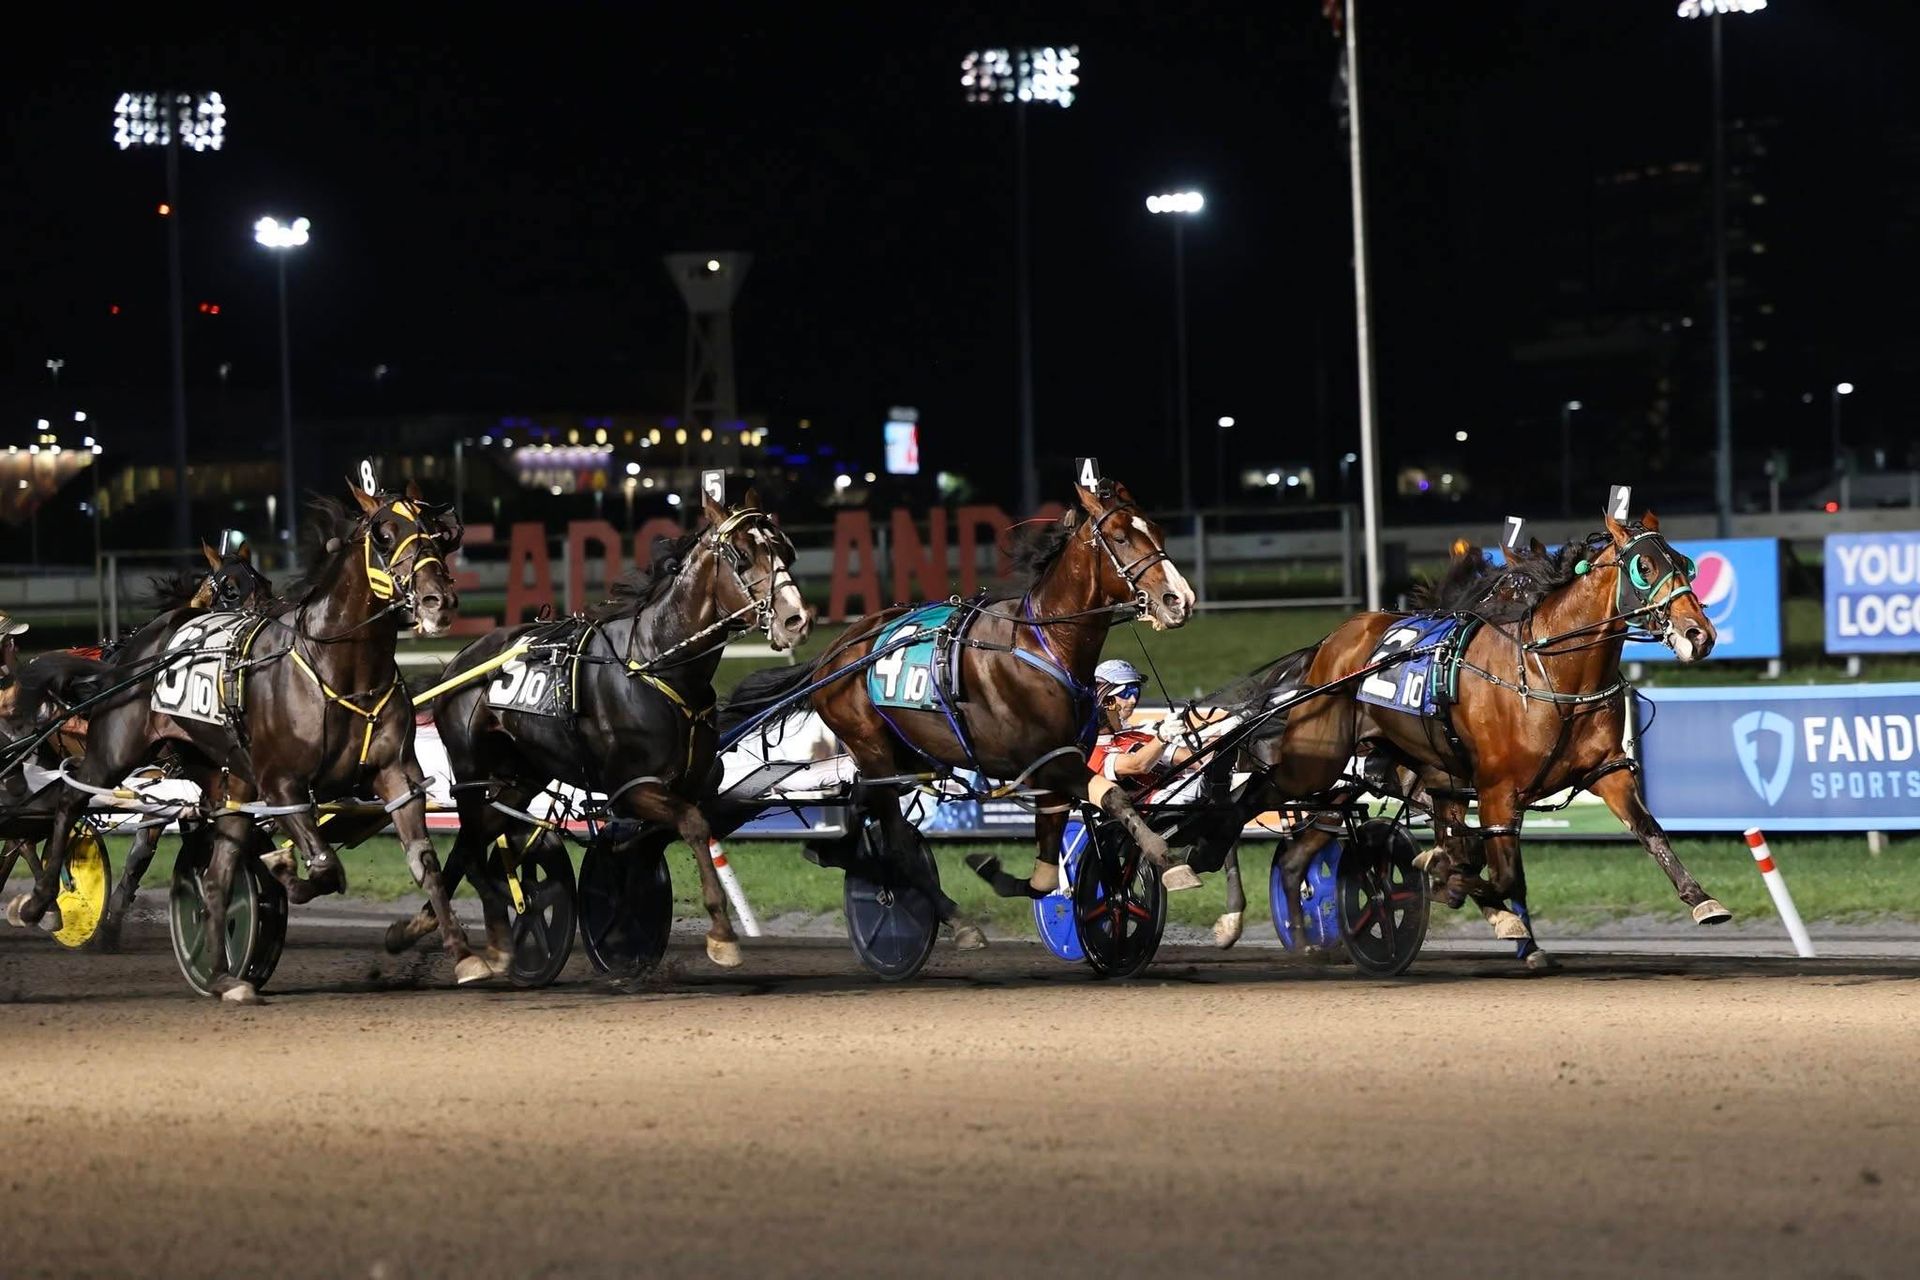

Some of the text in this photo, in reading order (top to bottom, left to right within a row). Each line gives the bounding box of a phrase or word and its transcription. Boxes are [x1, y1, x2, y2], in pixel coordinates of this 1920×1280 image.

[361, 459, 376, 497] 8
[705, 472, 722, 502] 5
[1080, 458, 1098, 493] 4
[1613, 486, 1629, 520] 2
[1507, 516, 1522, 548] 7
[1835, 544, 1920, 586] YOU
[192, 674, 212, 715] 10
[518, 670, 547, 706] 10
[904, 666, 929, 701] 10
[1401, 671, 1424, 708] 10
[1803, 714, 1920, 763] FAND
